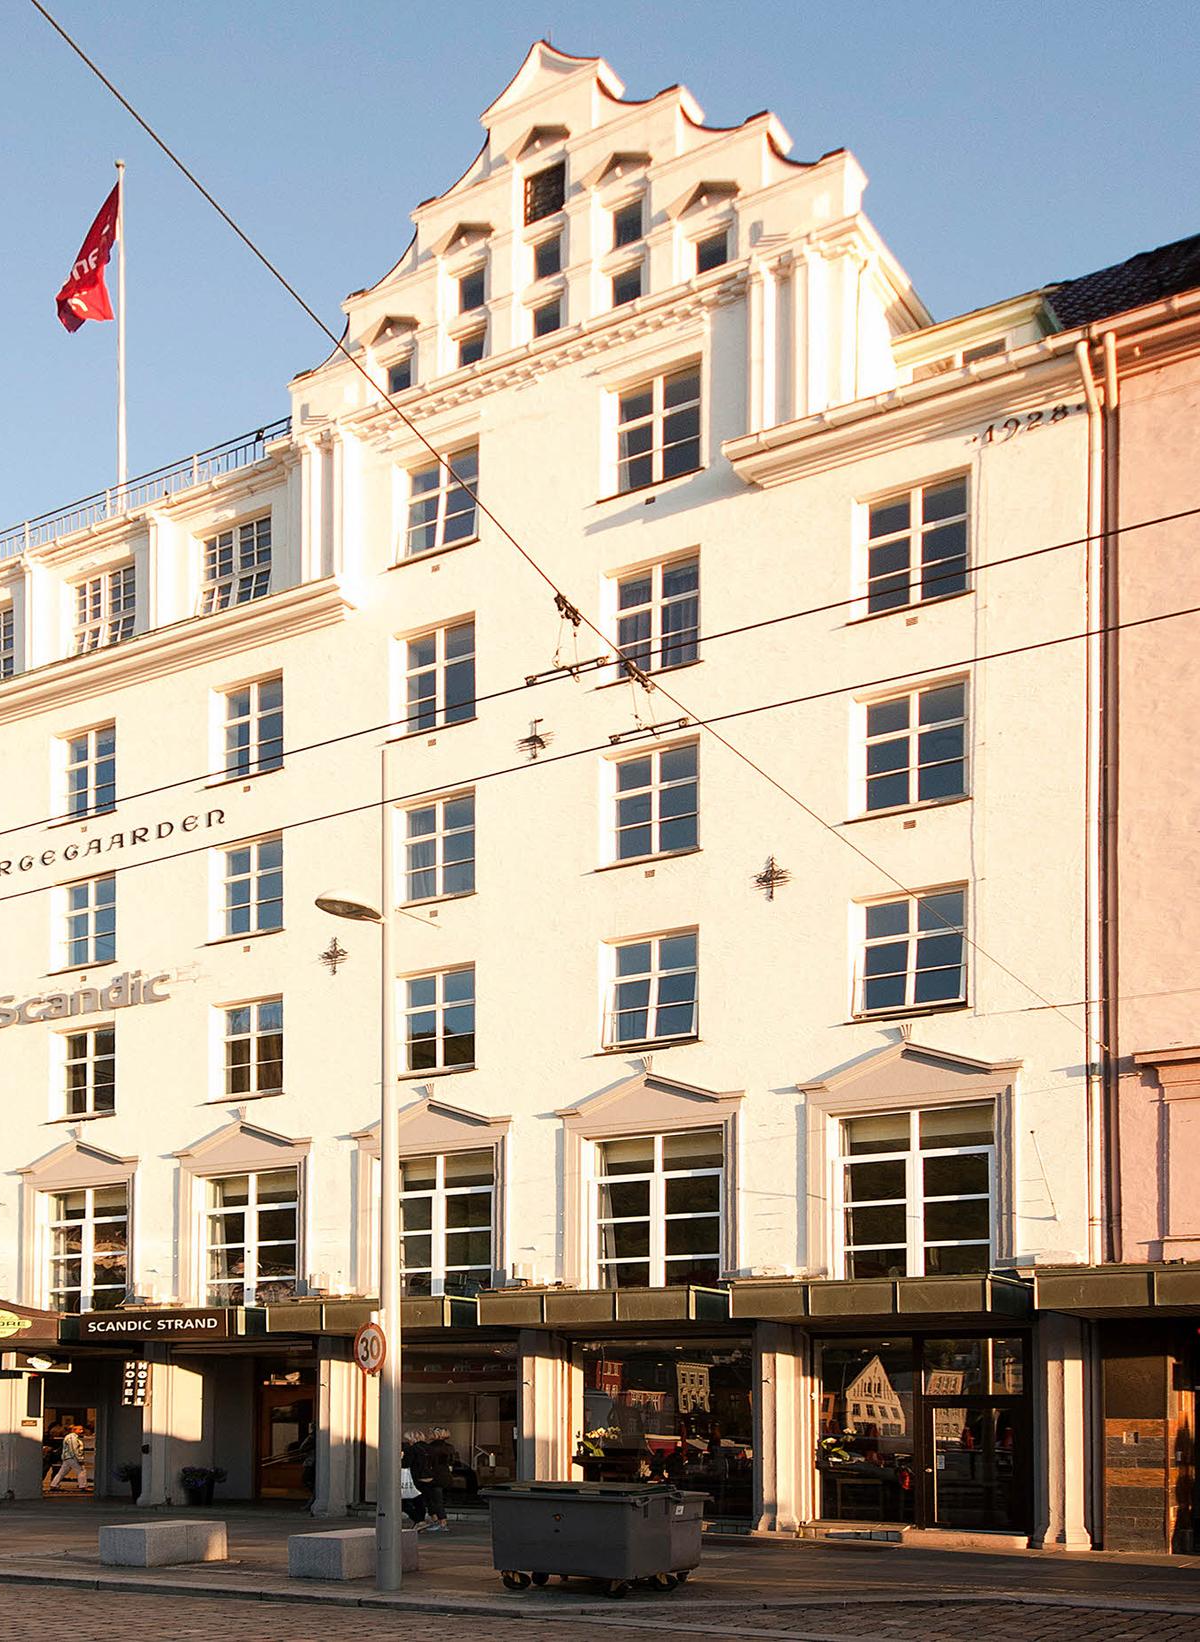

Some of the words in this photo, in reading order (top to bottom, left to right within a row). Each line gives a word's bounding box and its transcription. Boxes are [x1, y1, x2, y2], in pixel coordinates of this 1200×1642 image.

[87, 1319, 152, 1332] SCANDIC
[157, 1317, 218, 1330] STRAND
[360, 1335, 381, 1362] 30
[124, 1362, 136, 1405] HOTEL
[136, 1362, 148, 1406] HOTEL
